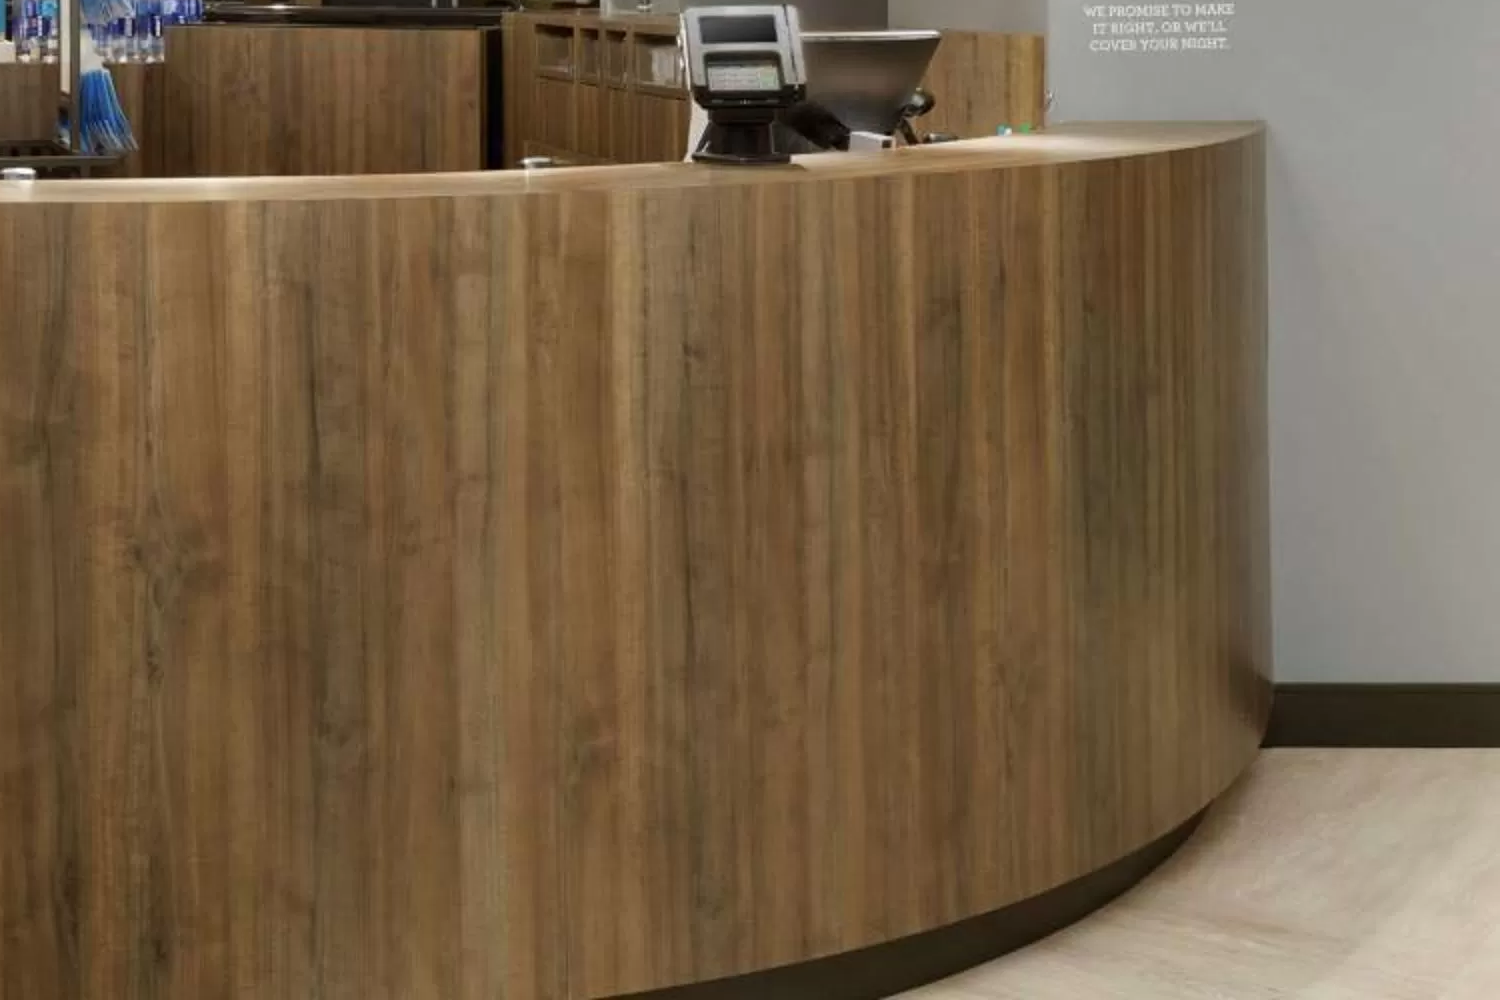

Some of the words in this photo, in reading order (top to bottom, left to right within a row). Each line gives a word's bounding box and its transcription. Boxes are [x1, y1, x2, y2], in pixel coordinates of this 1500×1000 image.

[1083, 5, 1108, 17] WE
[1109, 4, 1169, 17] PROMISE
[1171, 4, 1191, 16] TO
[1195, 3, 1235, 15] MAKE
[1093, 23, 1108, 35] IT
[1162, 21, 1181, 34] OR
[1089, 39, 1137, 52] COVER
[1140, 38, 1180, 51] YOUR
